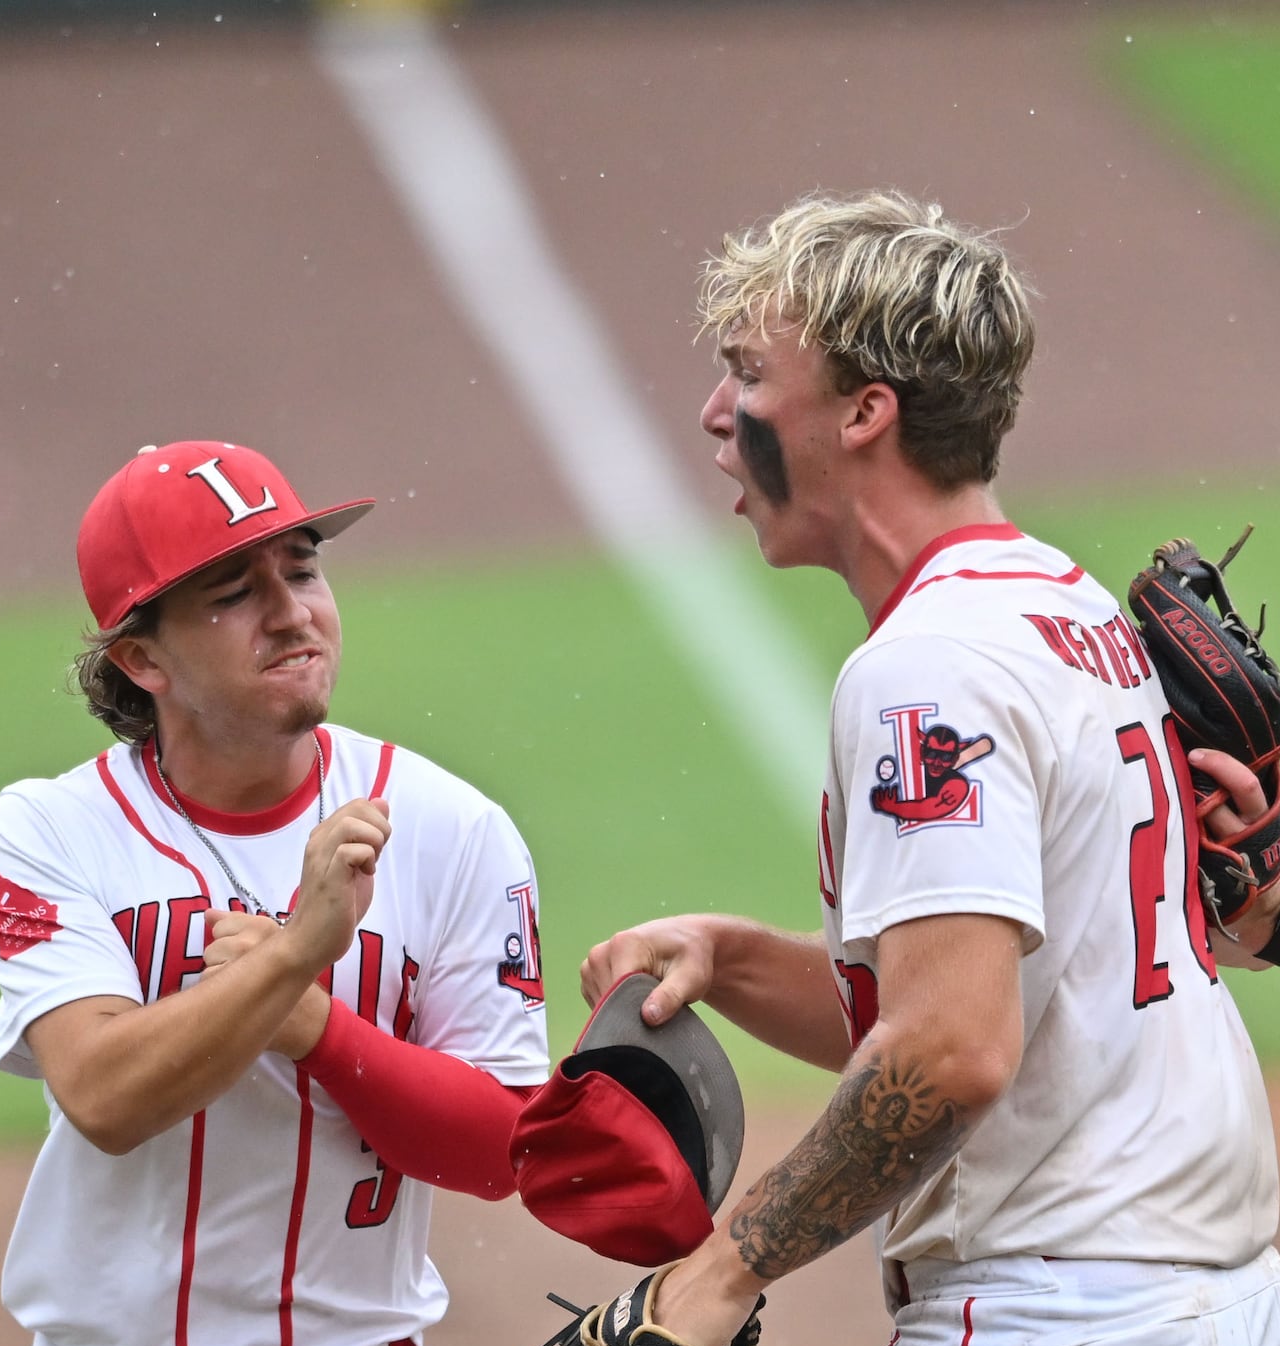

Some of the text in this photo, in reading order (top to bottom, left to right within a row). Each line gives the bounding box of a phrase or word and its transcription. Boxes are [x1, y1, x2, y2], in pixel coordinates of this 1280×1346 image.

[186, 457, 278, 527] L
[1161, 609, 1232, 676] A2000
[880, 702, 983, 839] L
